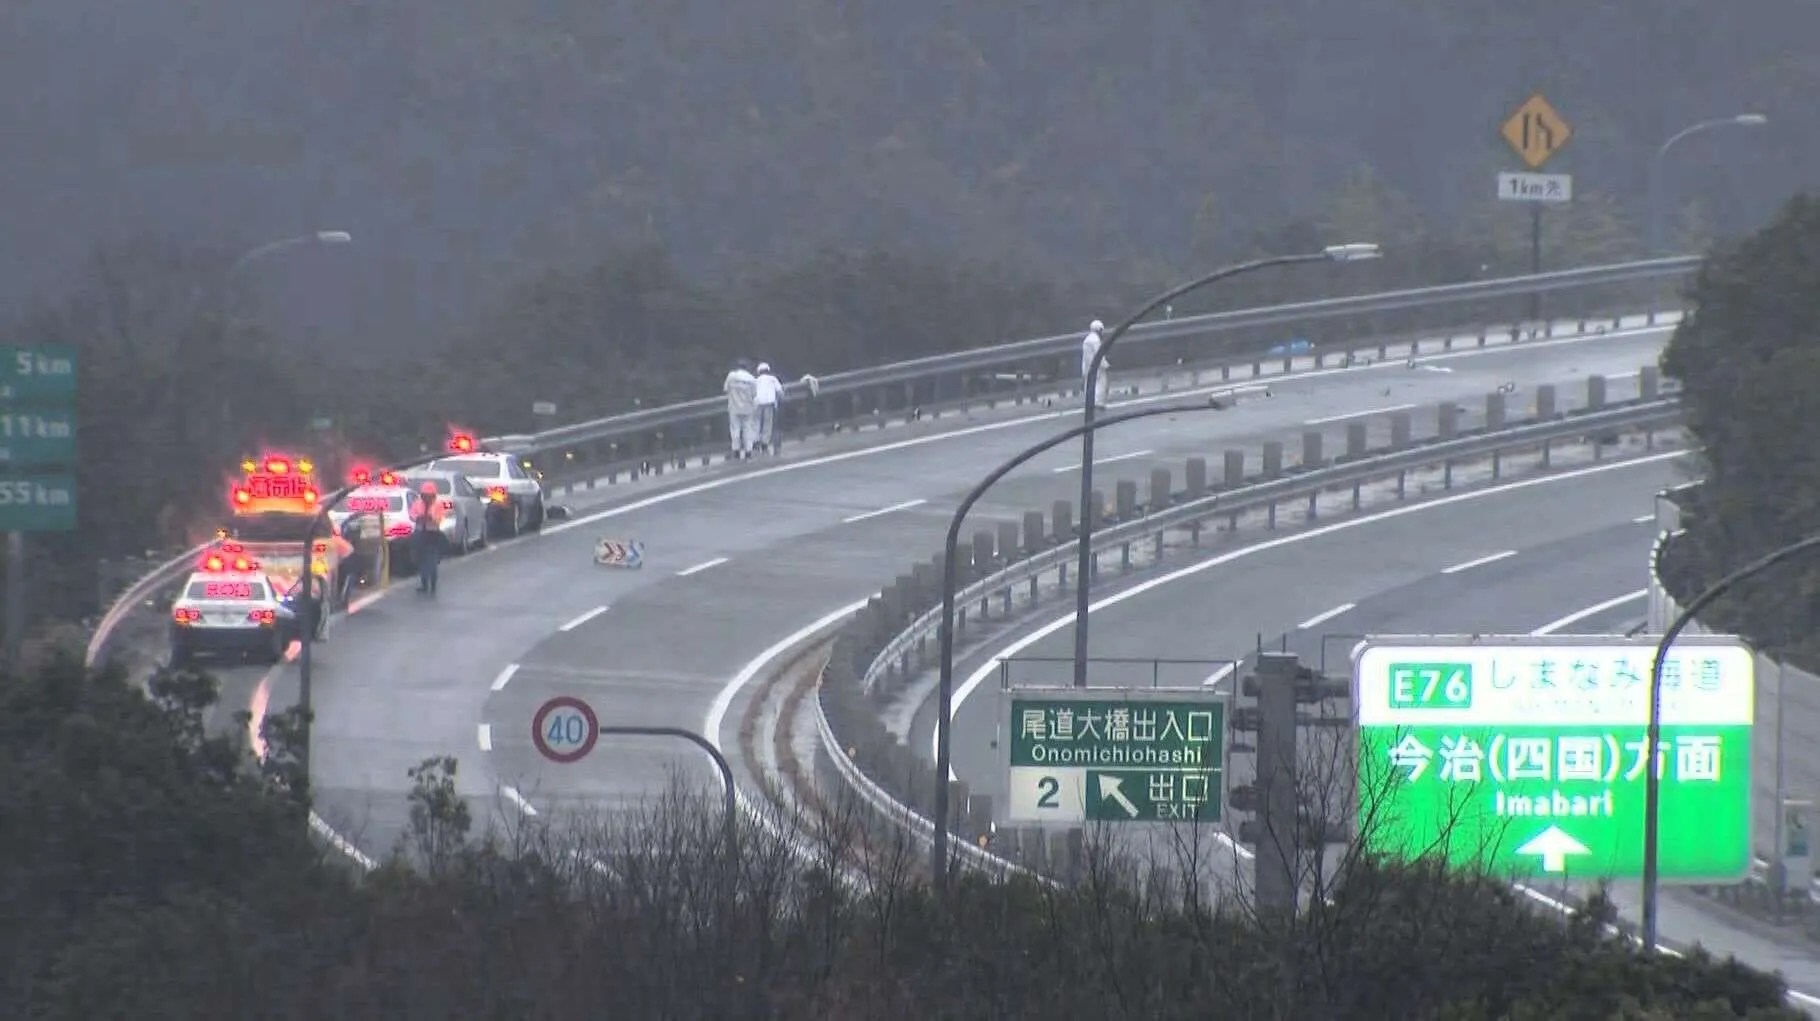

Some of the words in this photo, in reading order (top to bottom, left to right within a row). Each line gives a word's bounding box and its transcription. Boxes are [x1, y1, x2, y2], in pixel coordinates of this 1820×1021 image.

[1394, 669, 1468, 703] E76
[547, 714, 584, 745] 40
[1021, 707, 1213, 742] 尾道大橋出入口
[1031, 743, 1202, 764] Onomichiohashi
[1390, 733, 1722, 783] 今治(四国)方面
[1037, 775, 1060, 808] 2
[1149, 773, 1209, 802] 出口
[1495, 788, 1613, 816] Imabari
[1156, 804, 1197, 820] EXIT
